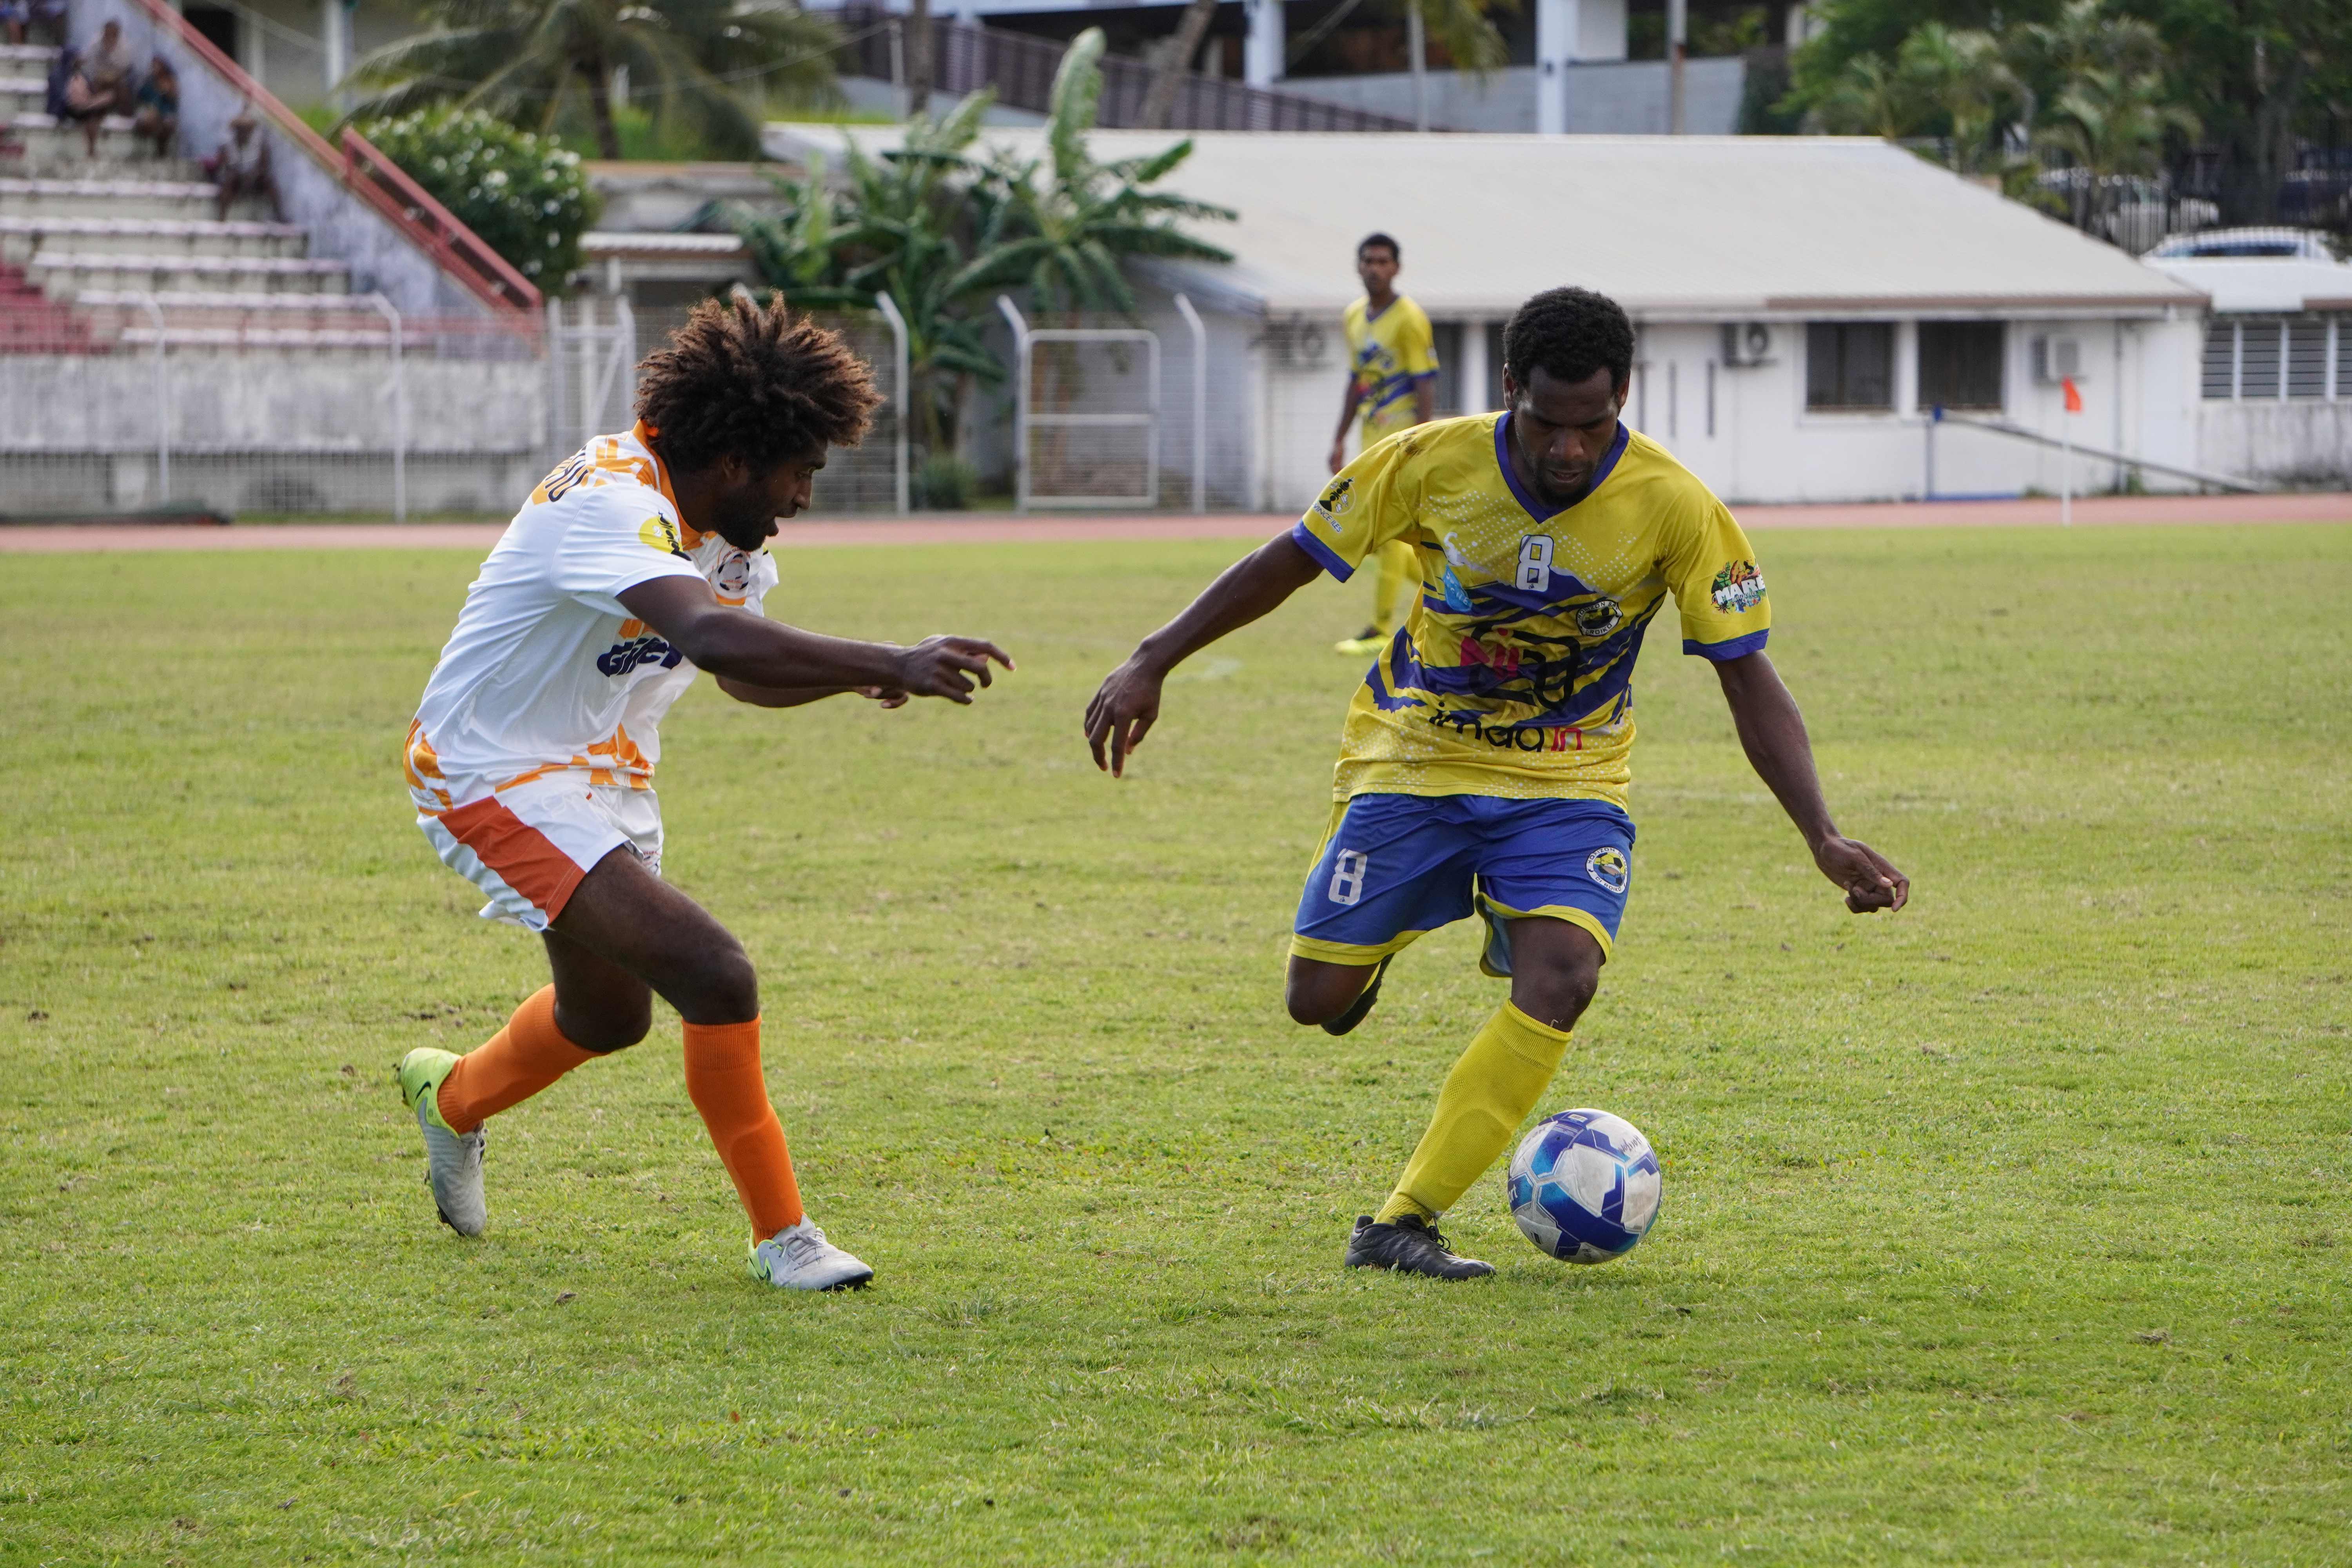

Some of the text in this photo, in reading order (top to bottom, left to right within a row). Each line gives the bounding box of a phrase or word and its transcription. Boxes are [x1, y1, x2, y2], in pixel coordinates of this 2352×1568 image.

[1515, 534, 1554, 592] 8
[1588, 848, 1615, 863] HORIZON
[1328, 848, 1367, 906] 8
[1604, 883, 1621, 892] ROIKO
